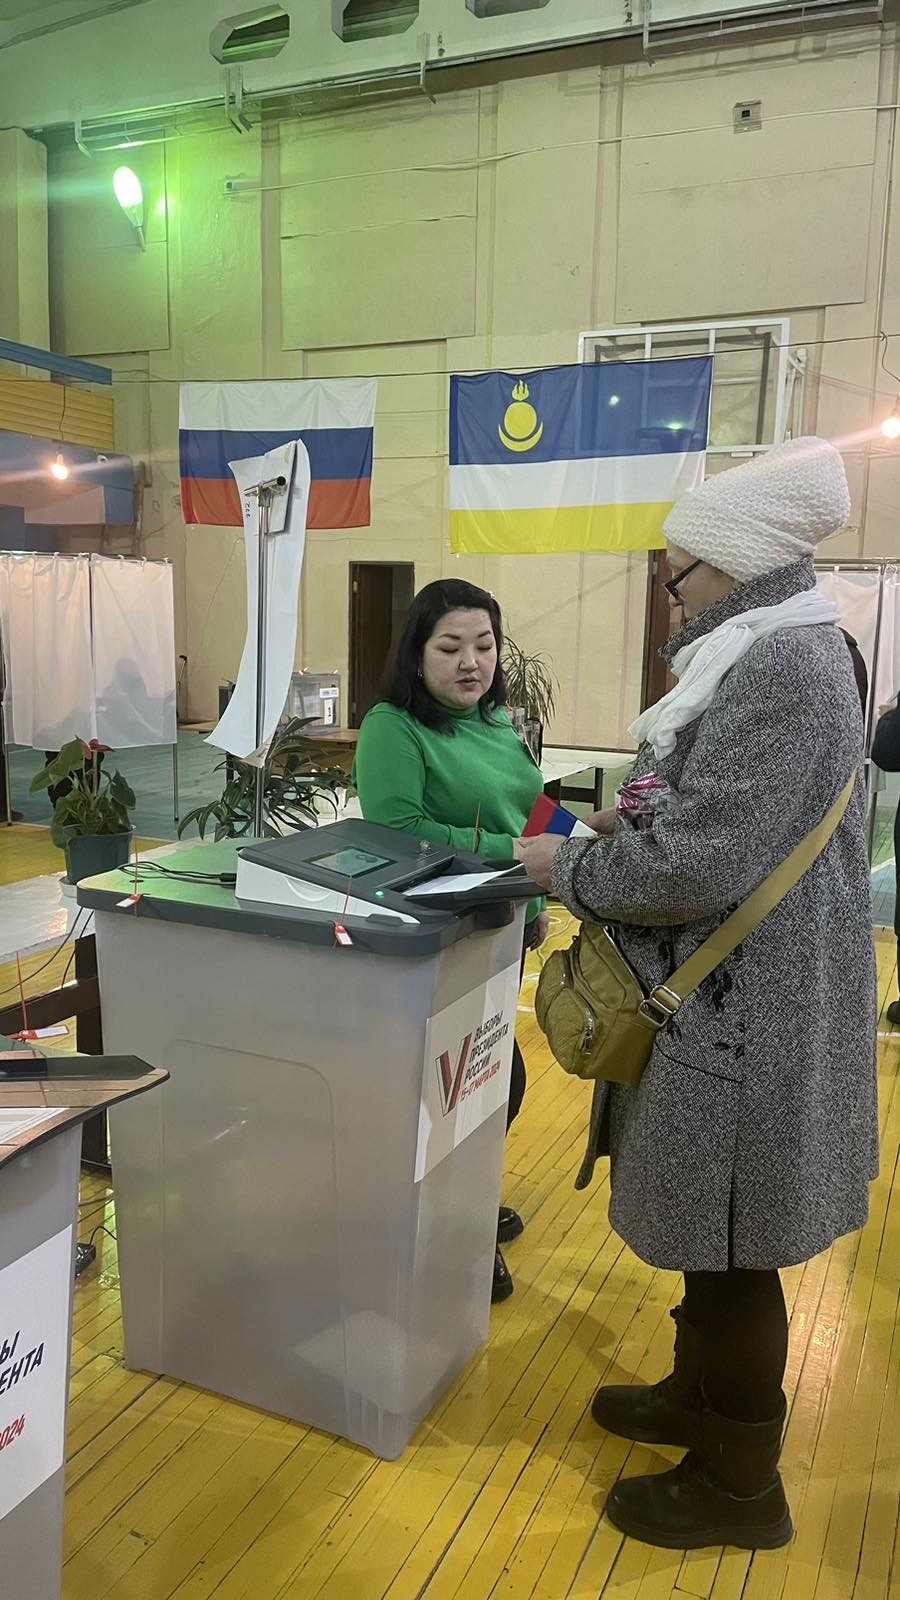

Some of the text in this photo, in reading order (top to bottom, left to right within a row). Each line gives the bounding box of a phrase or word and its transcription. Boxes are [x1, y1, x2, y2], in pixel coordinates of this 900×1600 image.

[469, 1022, 509, 1063] ПРЕЗИДЕНТА
[474, 1010, 503, 1043] ВЫБОРЫ
[464, 1051, 491, 1084] РОССИИ
[474, 1068, 489, 1092] МАРТА
[489, 1059, 501, 1078] 2024
[0, 1330, 20, 1365] Ы
[0, 1414, 25, 1451] 024
